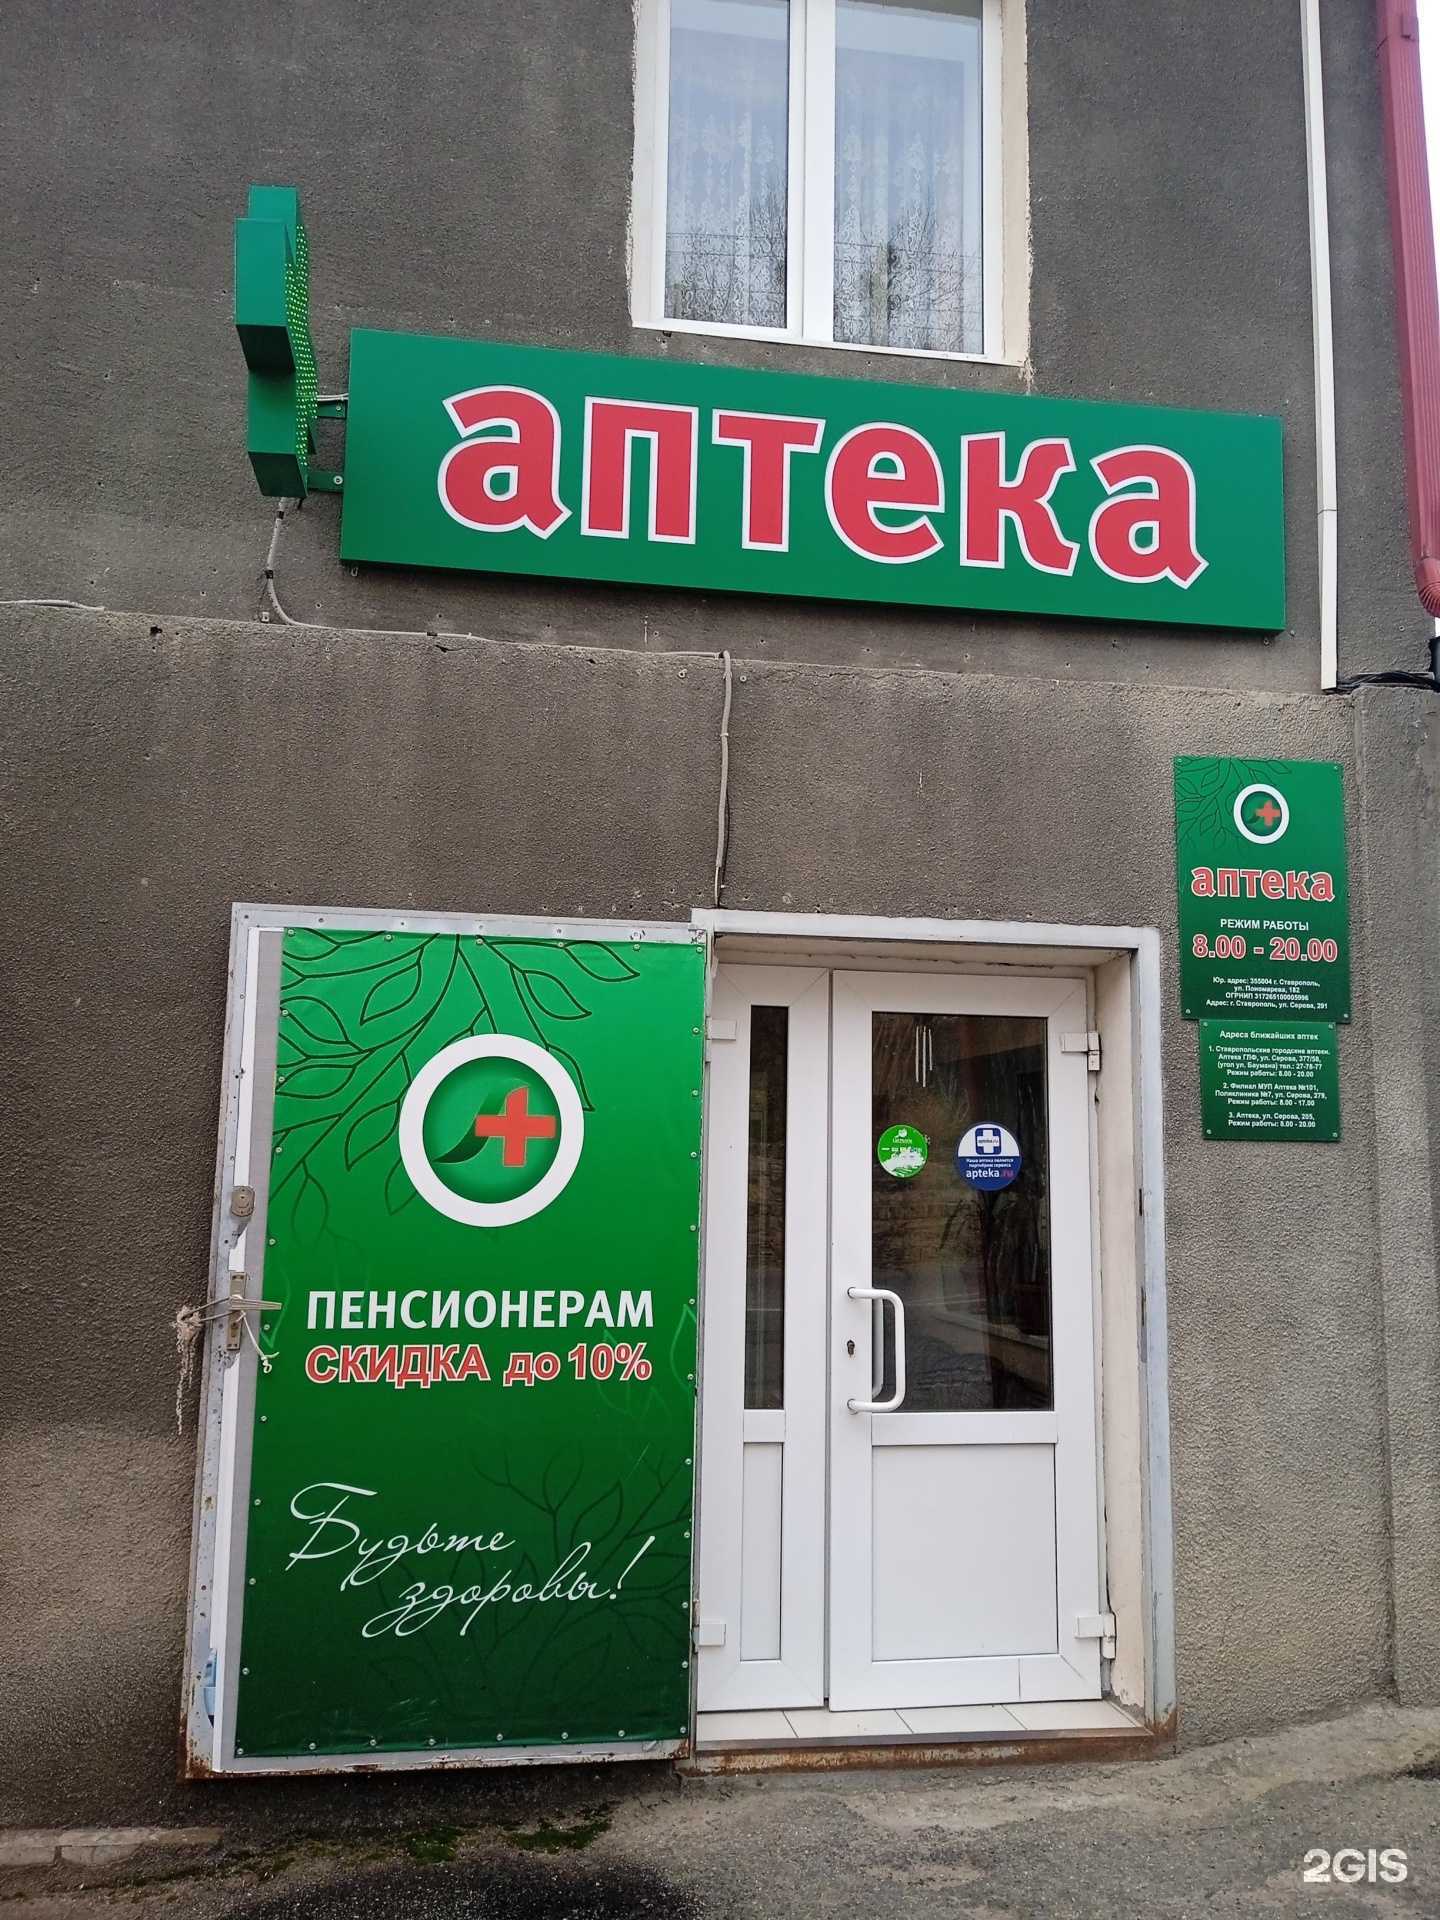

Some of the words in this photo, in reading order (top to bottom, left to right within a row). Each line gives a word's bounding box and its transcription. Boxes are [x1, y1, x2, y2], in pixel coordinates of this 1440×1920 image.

[437, 384, 1209, 590] аптека
[1191, 866, 1335, 902] аптека
[1220, 918, 1260, 929] РЕЖИМ
[1263, 920, 1309, 931] РАБОТЫ
[1192, 934, 1246, 959] 8.00
[1269, 937, 1338, 962] 20.00
[1228, 978, 1249, 986] адрес:
[1279, 979, 1320, 987] Ставрополь,
[1206, 999, 1229, 1007] Адрес:
[1236, 1000, 1277, 1008] Ставрополь,
[1290, 1002, 1316, 1010] Серова,
[1220, 1030, 1248, 1039] Адреса
[1250, 1031, 1295, 1039] ближайших
[1216, 1046, 1270, 1054] Ставропольские
[1218, 1061, 1234, 1069] (угол
[1247, 1062, 1278, 1070] Баумана)
[1251, 1120, 1279, 1128] работы:
[306, 1289, 654, 1330] ПЕНСИОНЕРАМ
[304, 1344, 491, 1389] СКИДКА
[503, 1352, 561, 1387] до
[568, 1342, 653, 1381] 10%
[285, 1481, 517, 1591] Будьте
[361, 1535, 655, 1639] здоровы!
